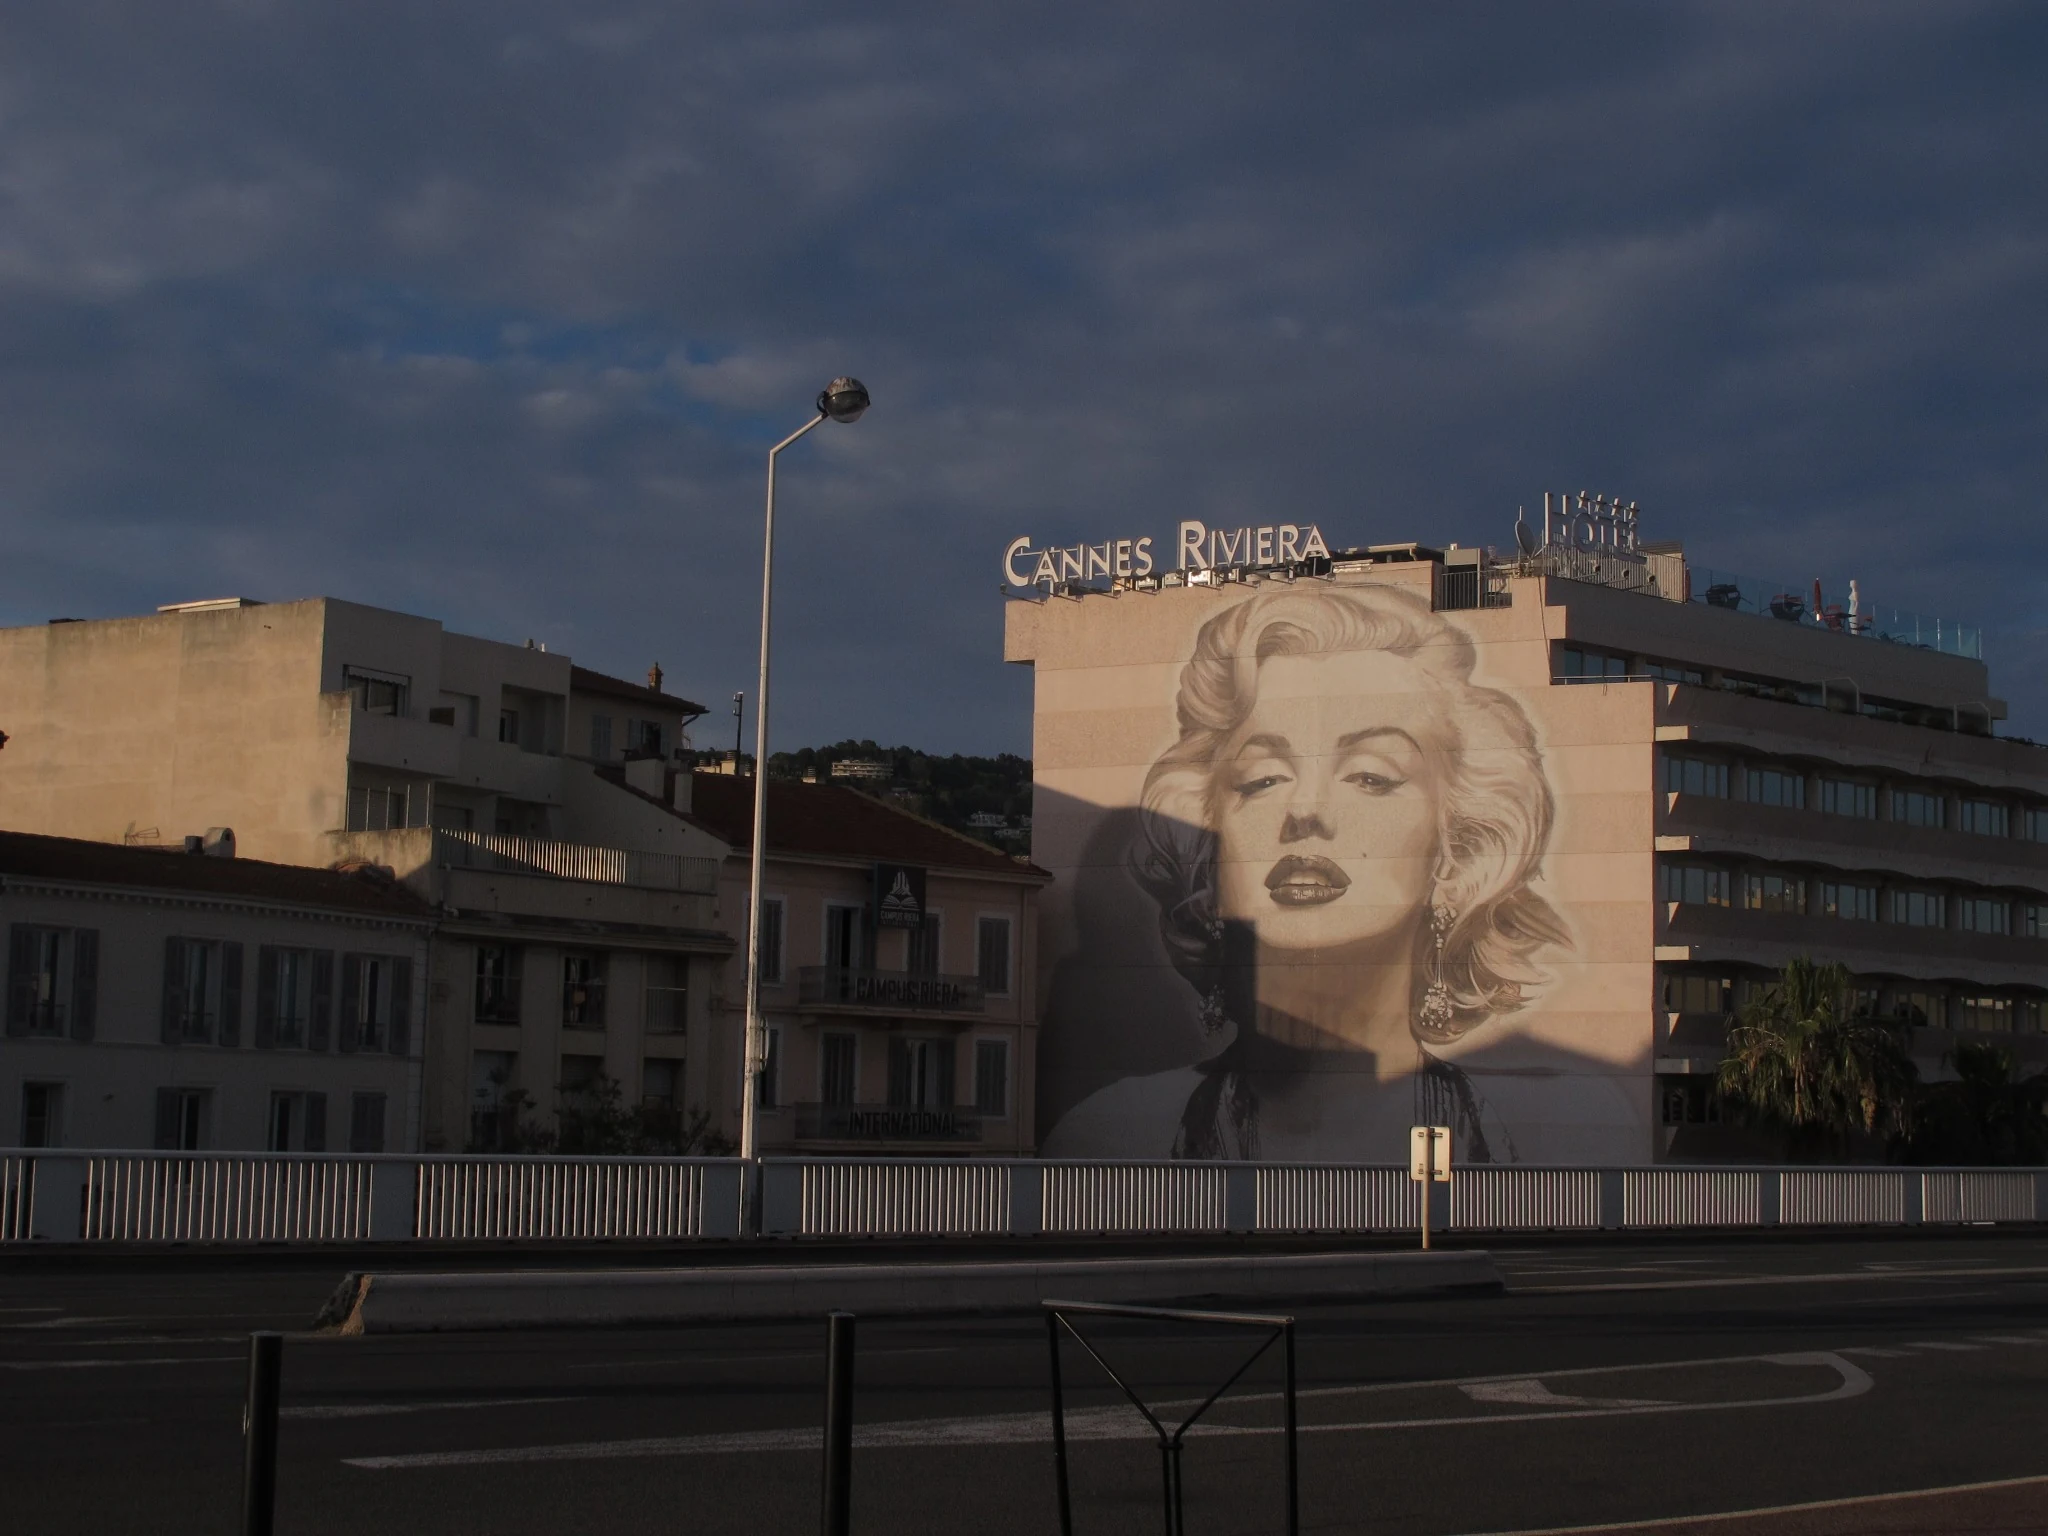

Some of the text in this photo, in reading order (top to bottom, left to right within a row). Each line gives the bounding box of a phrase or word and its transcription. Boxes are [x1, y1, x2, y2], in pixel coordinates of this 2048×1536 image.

[1544, 492, 1648, 565] HOTEL
[1003, 520, 1331, 587] CANNES RIVIERA
[880, 910, 920, 923] CAMPUS RIERA
[856, 976, 960, 1005] CAMPUS RIERA
[848, 1111, 959, 1135] INTERNATIONAL
